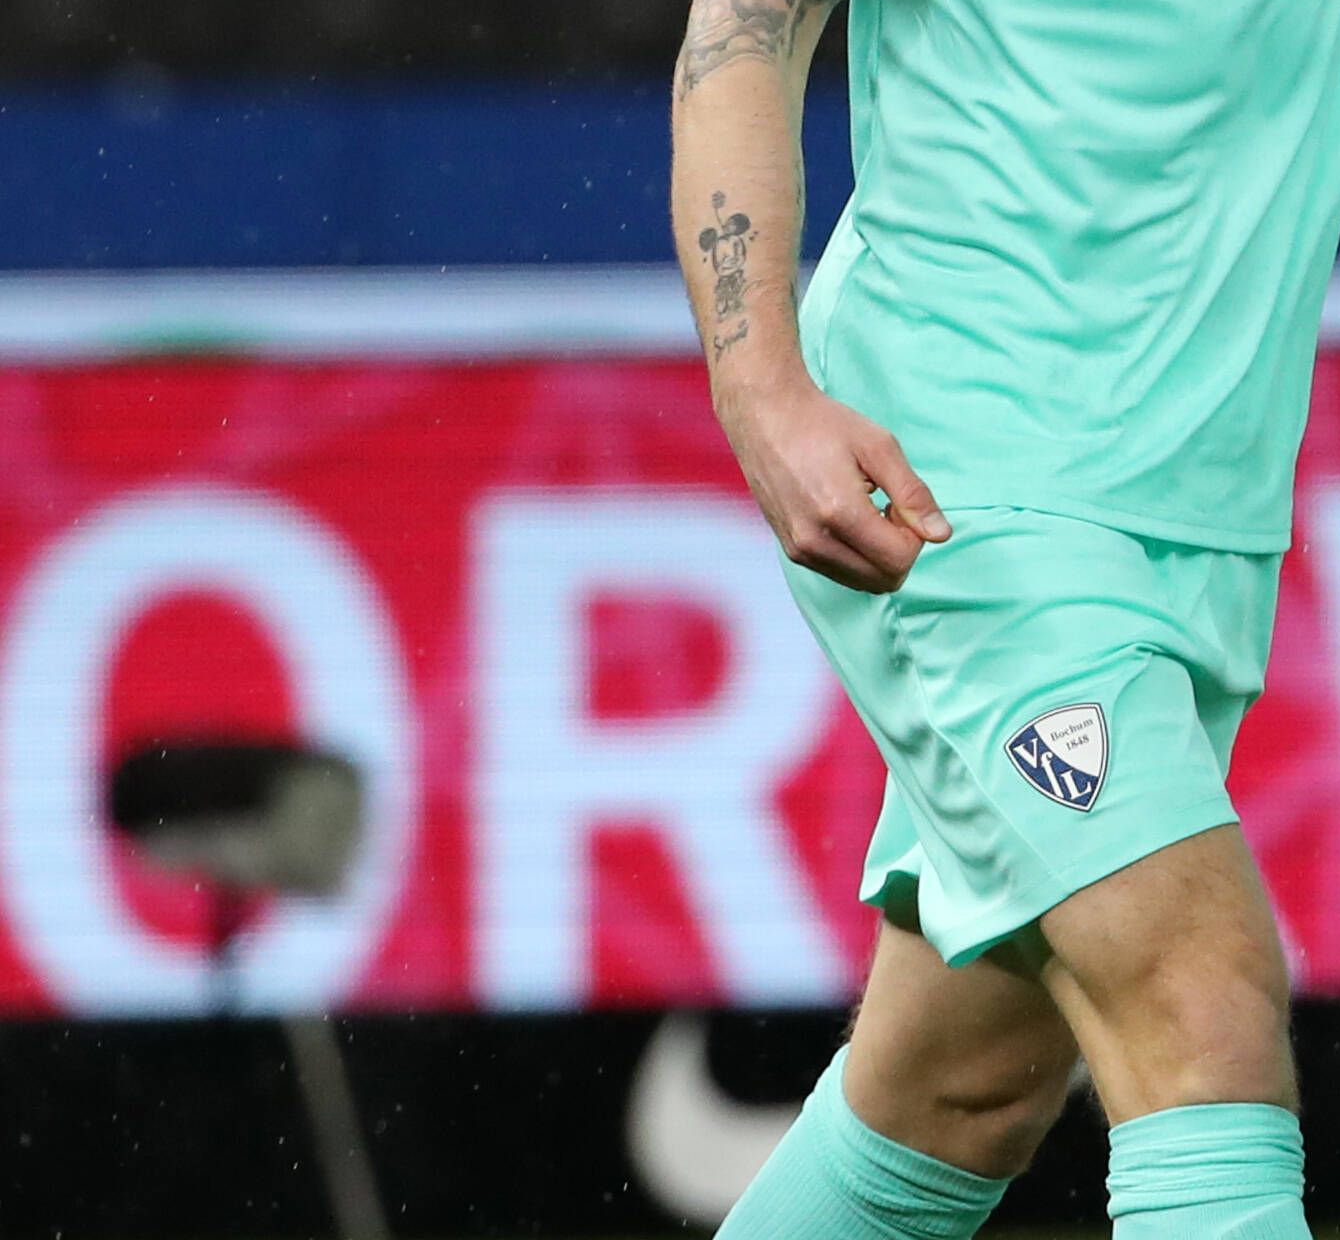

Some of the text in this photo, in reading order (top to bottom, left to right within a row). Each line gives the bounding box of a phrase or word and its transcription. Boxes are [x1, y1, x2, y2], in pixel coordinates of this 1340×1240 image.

[1049, 718, 1094, 742] Bochum
[1065, 733, 1090, 752] 1848
[1012, 737, 1092, 801] VfL
